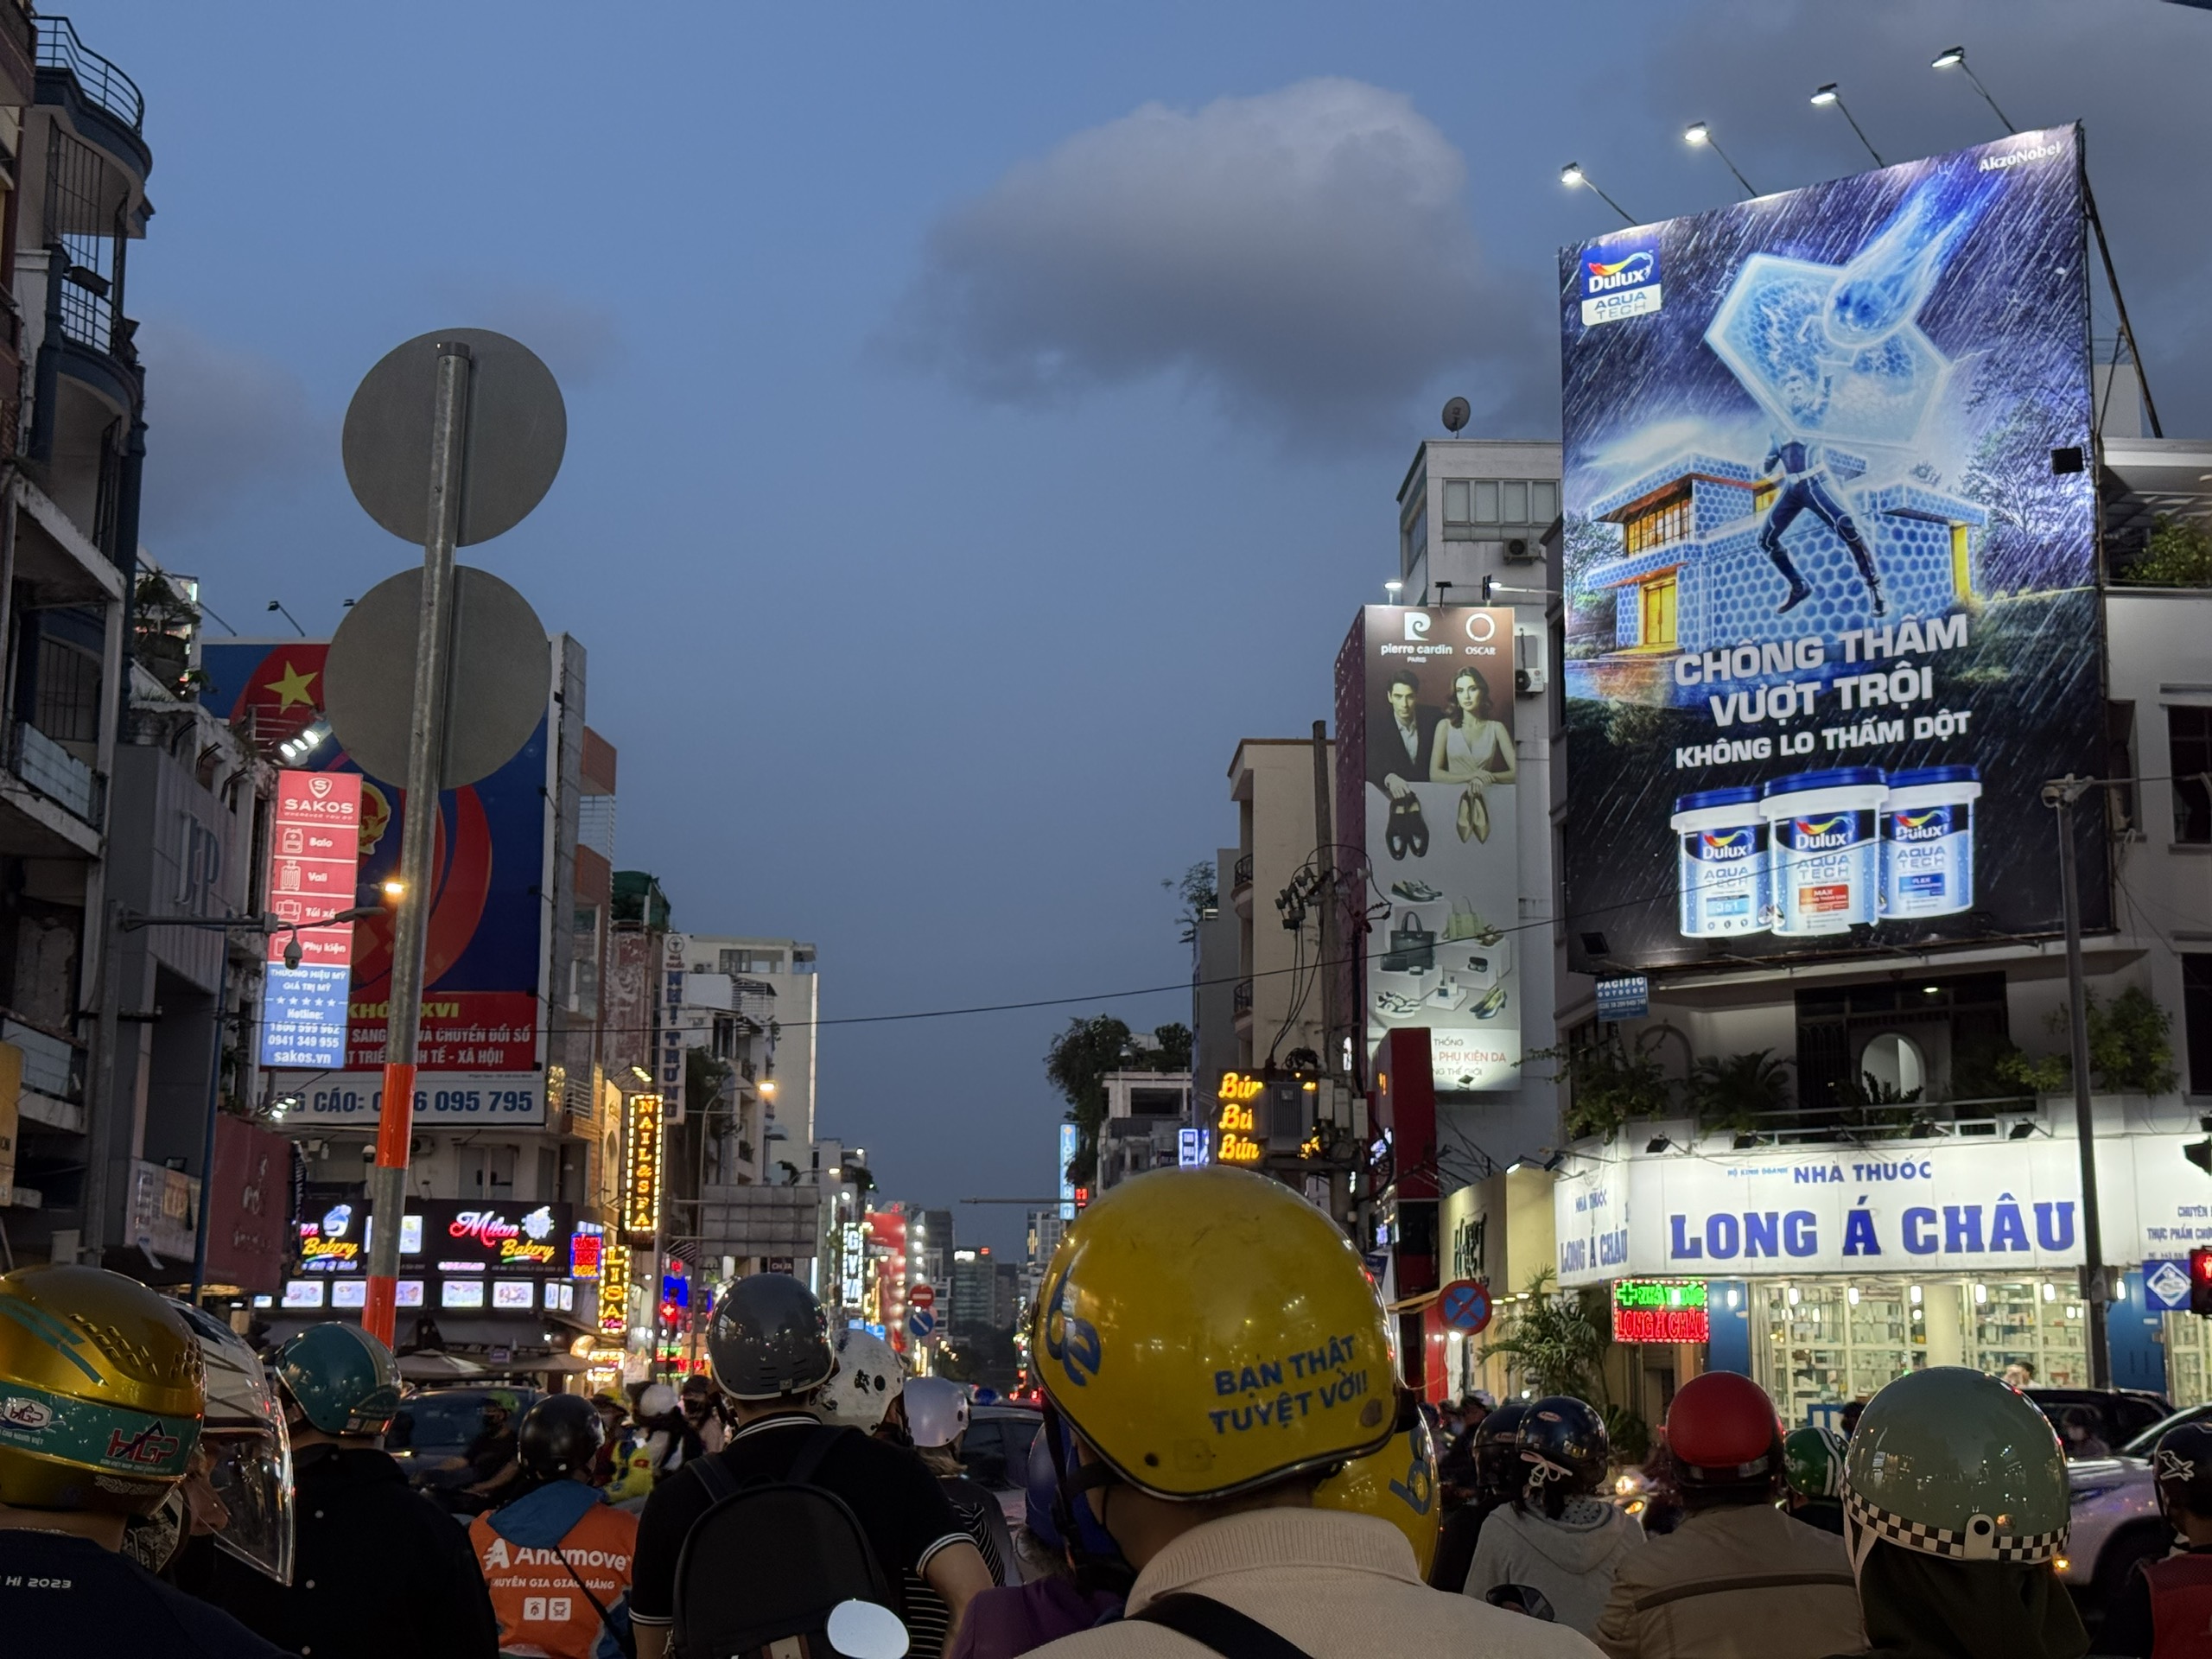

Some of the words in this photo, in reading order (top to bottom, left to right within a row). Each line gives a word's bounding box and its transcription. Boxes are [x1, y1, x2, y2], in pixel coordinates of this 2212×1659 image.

[1979, 141, 2062, 174] AkzoNobel
[1589, 270, 1645, 293] Dulux
[1594, 290, 1647, 311] AQUA
[1597, 302, 1647, 321] TECH
[1381, 643, 1414, 657] pierre
[1417, 644, 1453, 655] cardin
[1465, 646, 1497, 656] OSCAR
[1675, 634, 1825, 685] CHỐNG
[1838, 609, 1968, 664] THẤM
[1709, 681, 1822, 728] VƯỢT
[1834, 661, 1934, 711] TRỘI
[1675, 737, 1772, 769] KHÔNG
[1780, 731, 1815, 757] LO
[1821, 715, 1905, 751] THẤM
[1913, 709, 1973, 741] DỘT
[284, 798, 354, 814] SAKOS
[1796, 830, 1848, 851] Dulux
[1896, 823, 1945, 842] Dulux
[309, 837, 334, 848] Balo
[1703, 843, 1748, 861] Dulux
[1796, 854, 1850, 870] AQUA
[1897, 846, 1946, 859] AQUA
[1900, 855, 1945, 869] TECH
[1704, 866, 1749, 880] AQUA
[1800, 866, 1850, 880] TECH
[1597, 977, 1644, 990] PACIFIC
[287, 1007, 325, 1020] Hotline:
[347, 999, 389, 1018] KHÓ
[421, 1002, 460, 1017] XVI
[268, 1034, 294, 1046] 0941
[297, 1035, 317, 1047] 349
[274, 1049, 332, 1065] sakos.vn
[1439, 1051, 1460, 1065] PHỤ
[1464, 1049, 1488, 1065] KIỆN
[1491, 1052, 1506, 1062] DA
[314, 1086, 365, 1113] CÁO:
[435, 1090, 480, 1112] 095
[488, 1090, 533, 1112] 795
[1218, 1103, 1253, 1130] Bú
[1218, 1134, 1260, 1160] Bún
[1794, 1160, 1845, 1184] NHÀ
[1853, 1154, 1932, 1182] THUỐC
[448, 1211, 520, 1247] Milan
[1670, 1210, 1817, 1261] LONG
[1842, 1195, 1882, 1256] Á
[1901, 1192, 2076, 1255] CHÂU
[302, 1237, 359, 1260] Bakery
[500, 1239, 556, 1263] Bakery
[604, 1249, 625, 1319] LISA
[1617, 1310, 1654, 1338] LONG
[1669, 1306, 1707, 1338] CHÂU
[1215, 1360, 1283, 1398] BẠN
[1287, 1333, 1355, 1378] THẬT
[1209, 1390, 1313, 1434] TUYỆT
[28, 1577, 72, 1589] 2023
[530, 1578, 550, 1587] GIA
[586, 1578, 615, 1590] HÀNG
